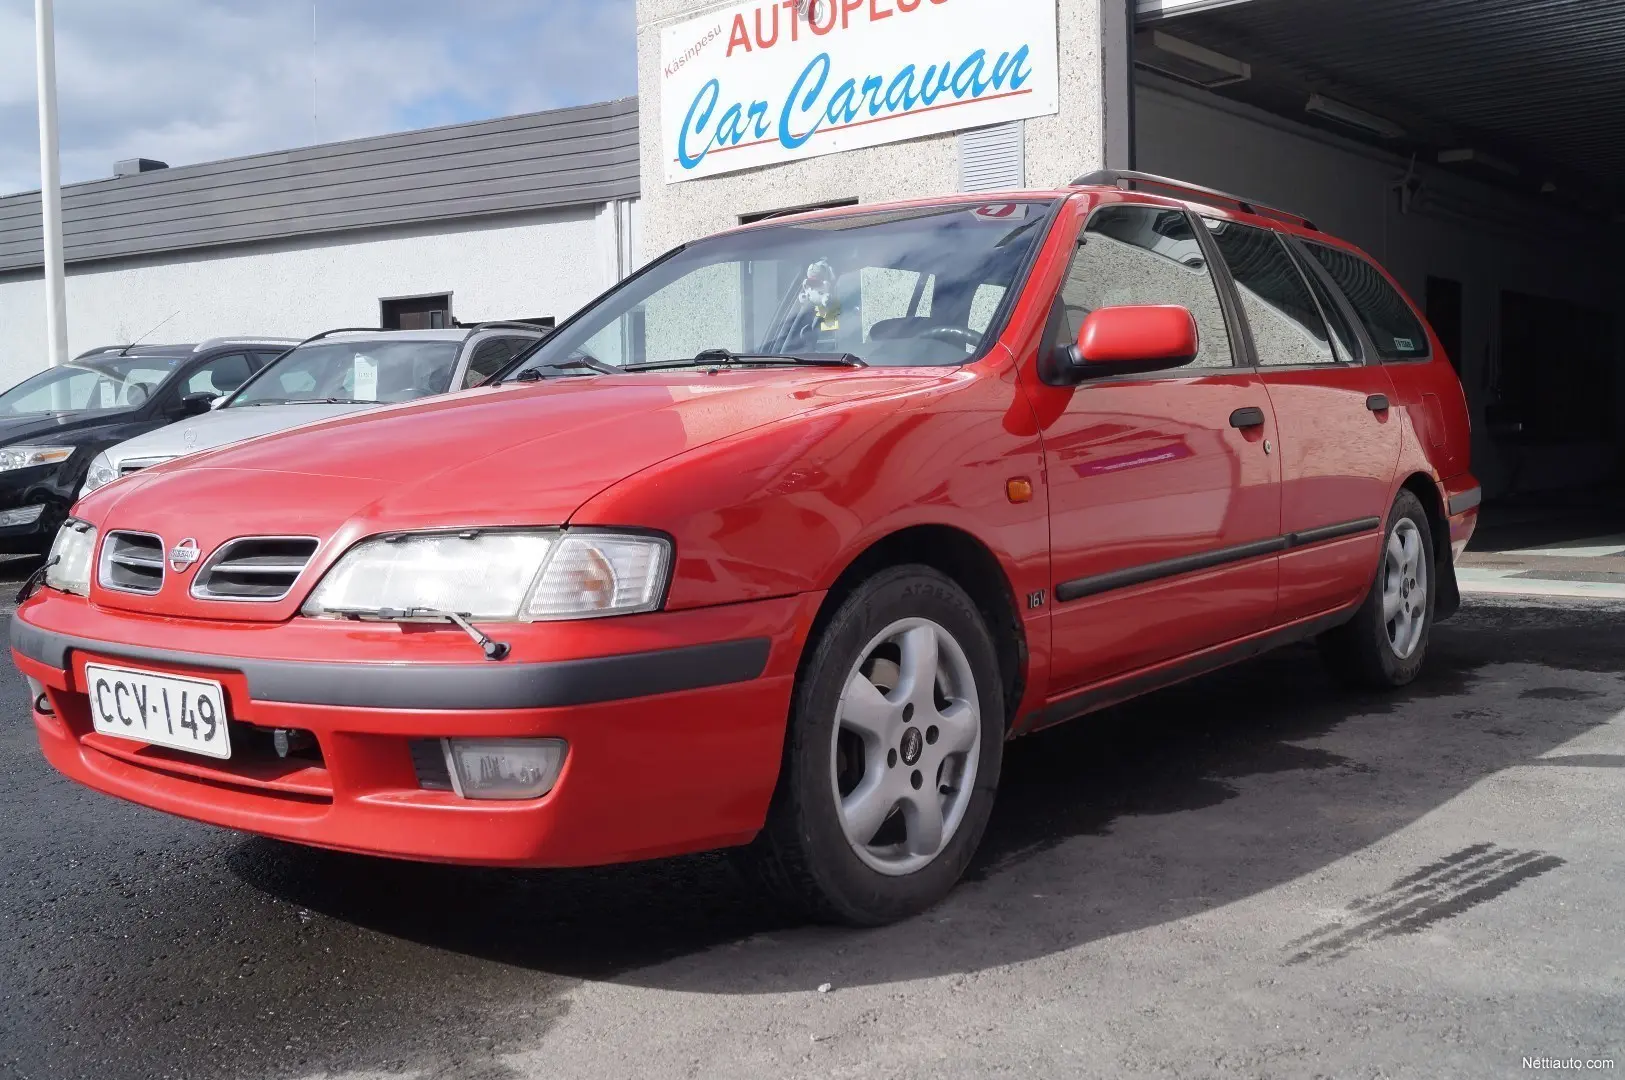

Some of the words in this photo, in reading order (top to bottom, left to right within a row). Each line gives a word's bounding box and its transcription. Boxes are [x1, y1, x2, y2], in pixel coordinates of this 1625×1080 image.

[664, 23, 722, 79] Käsinpesu
[677, 78, 772, 170] Car
[778, 43, 1033, 150] Caravan
